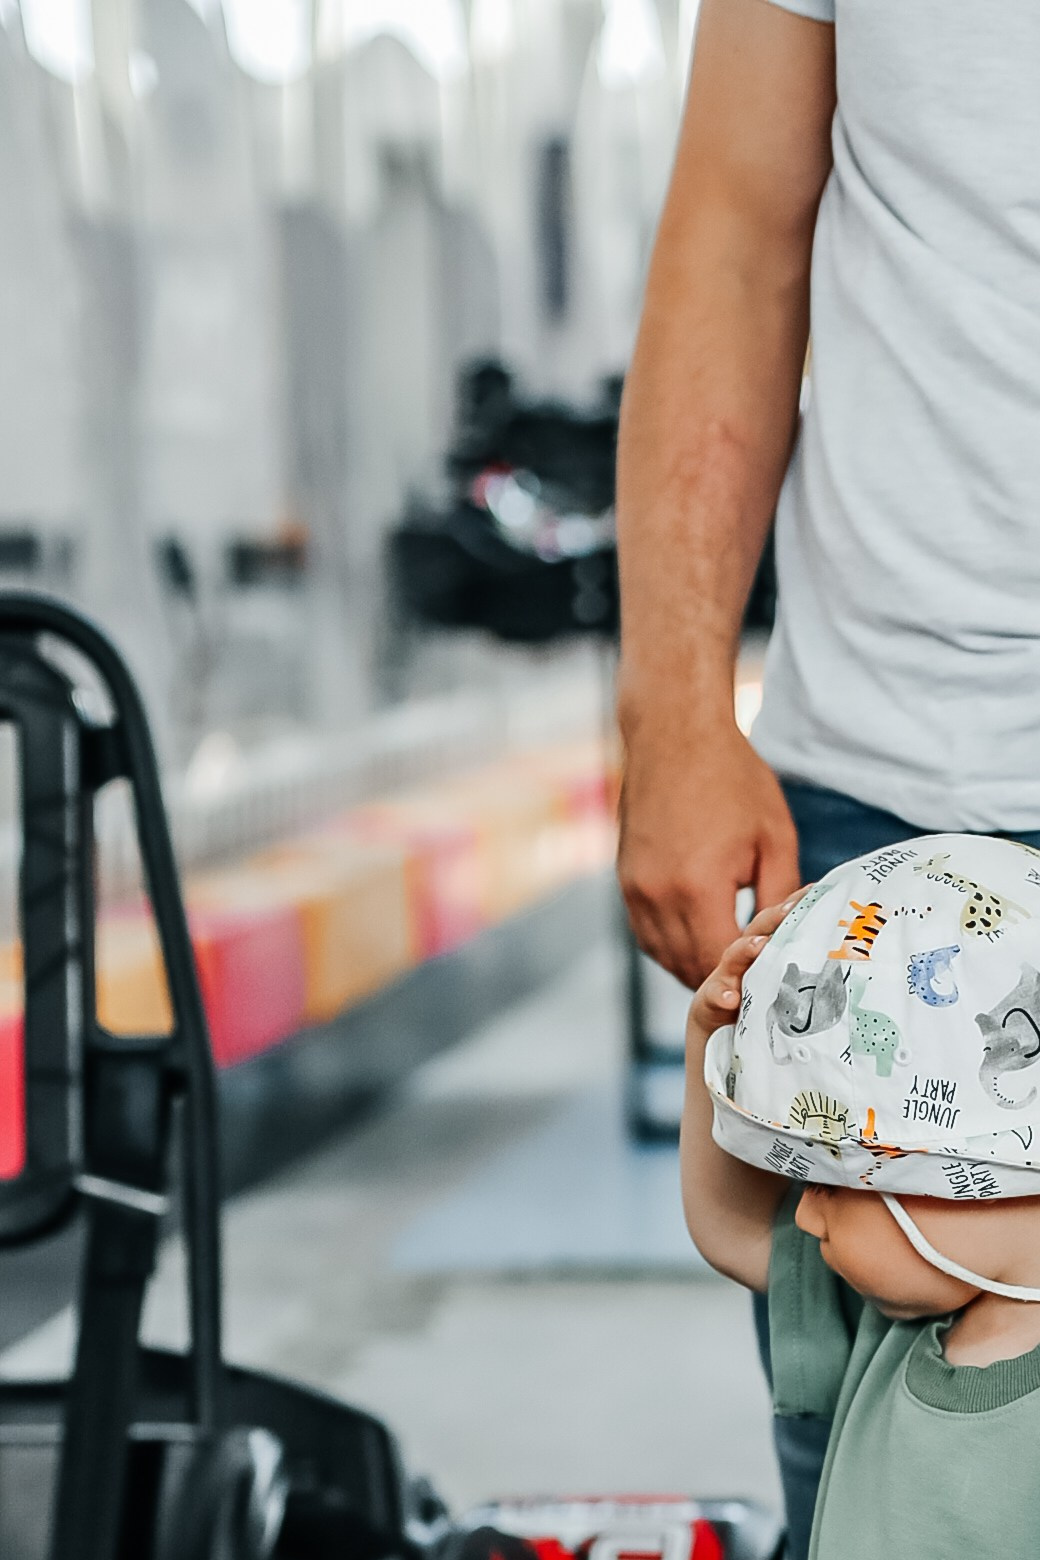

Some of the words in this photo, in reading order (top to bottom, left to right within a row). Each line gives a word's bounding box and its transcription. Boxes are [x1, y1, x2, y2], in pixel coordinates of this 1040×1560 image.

[866, 850, 919, 885] JUNGLE
[909, 1074, 957, 1105] PARTY
[902, 1099, 961, 1130] JUNGLE
[763, 1137, 794, 1173] JUNGLE
[966, 1161, 1002, 1198] PARTY
